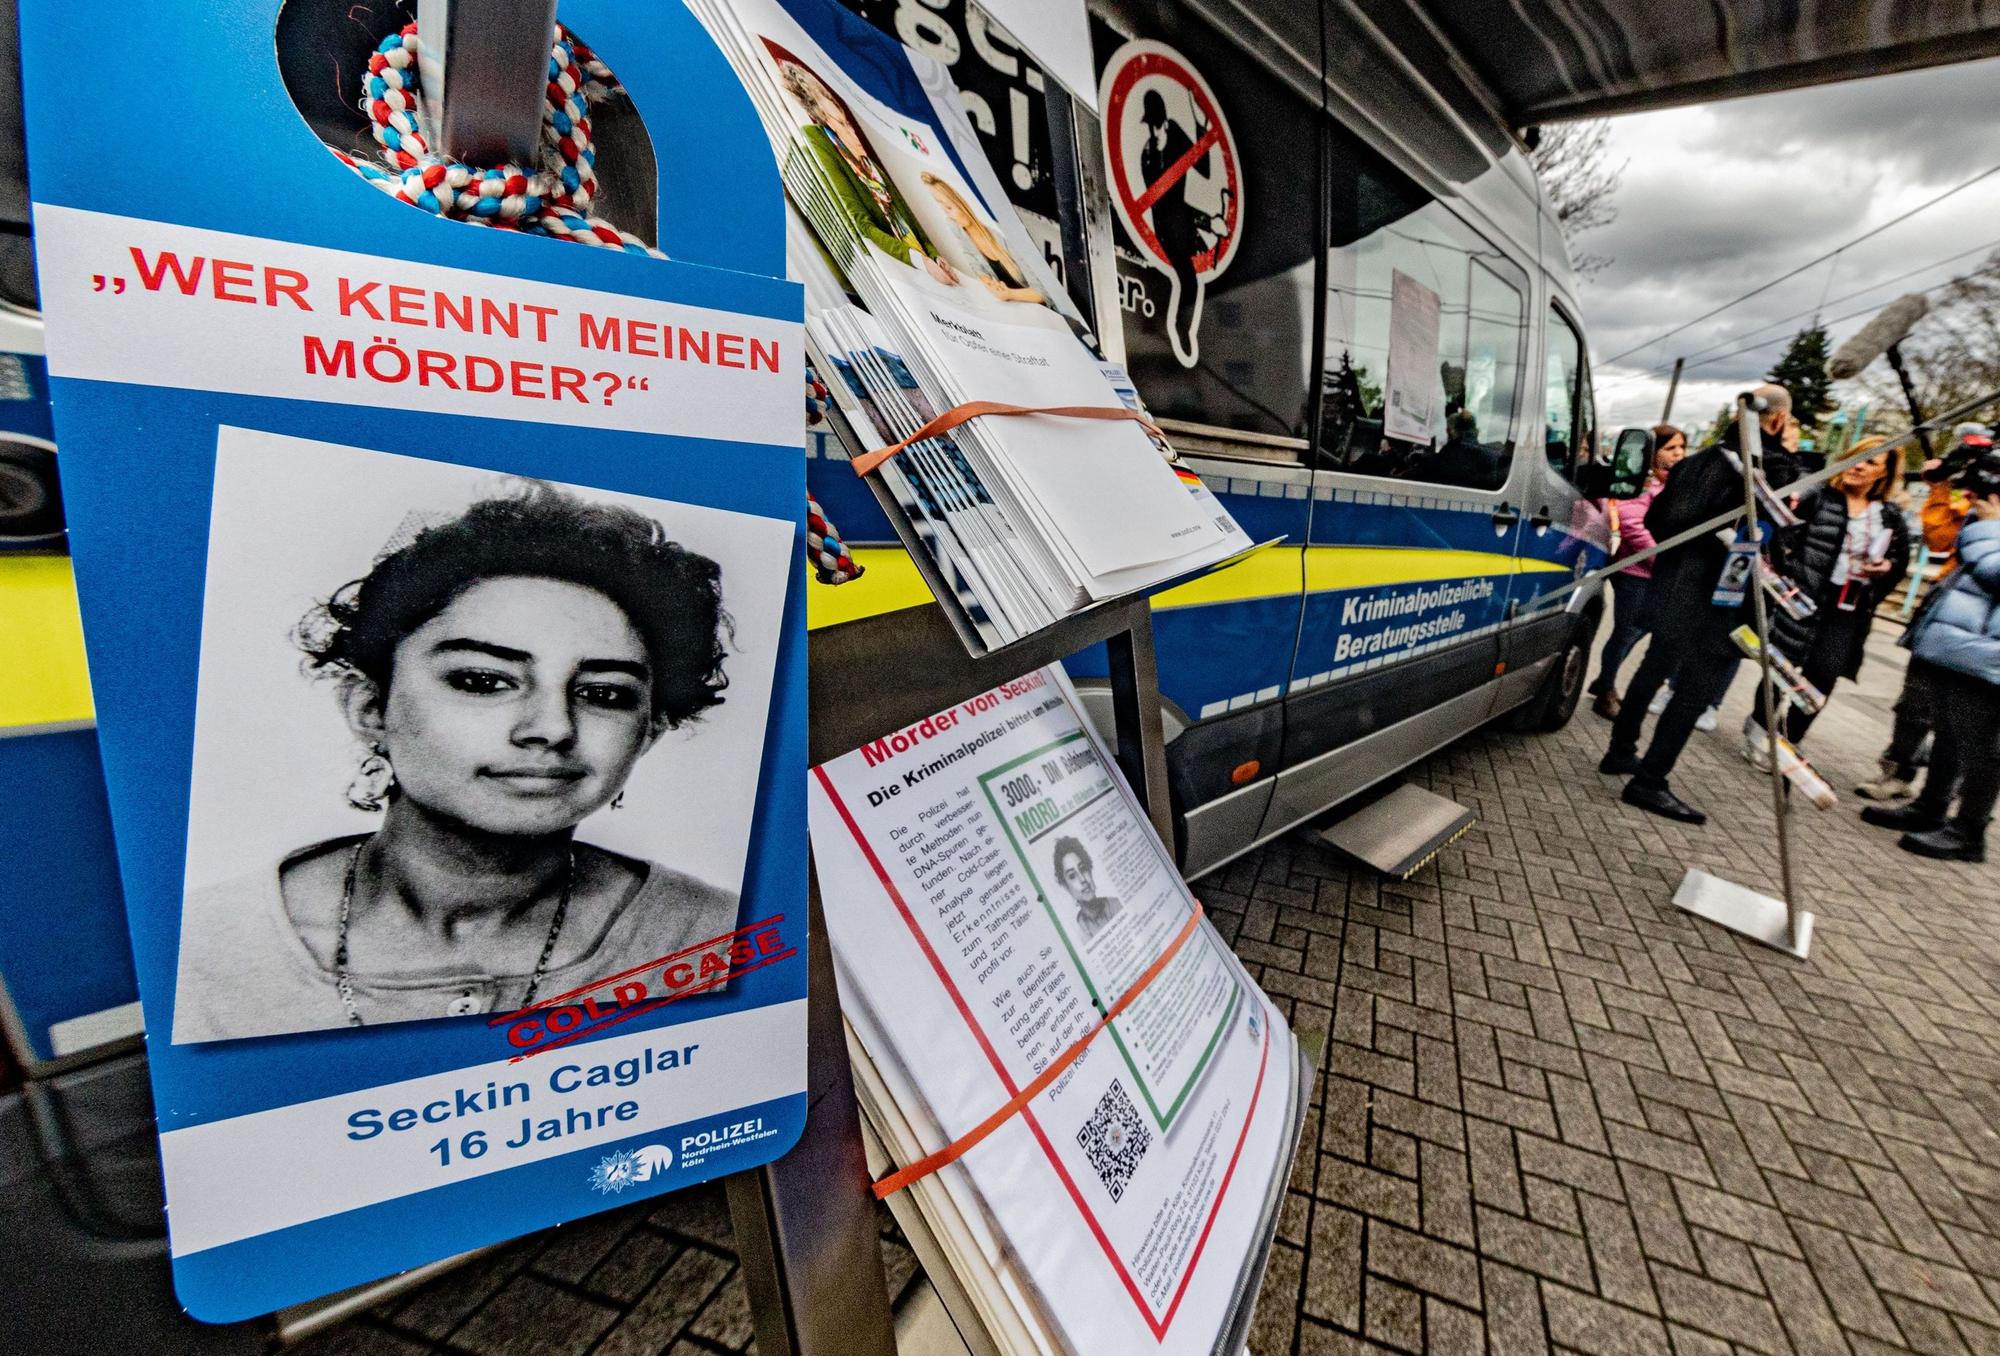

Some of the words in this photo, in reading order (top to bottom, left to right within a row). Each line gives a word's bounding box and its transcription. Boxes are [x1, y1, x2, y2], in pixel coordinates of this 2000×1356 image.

[337, 276, 560, 343] KENNT
[578, 312, 781, 374] MEINEN
[929, 310, 986, 341] Merkblatt
[302, 334, 651, 407] MÖRDER?“
[1340, 577, 1494, 626] Kriminalpolizeiliche
[1332, 608, 1466, 663] Beratungsstelle
[859, 707, 961, 769] Mörder
[962, 690, 1001, 718] von
[998, 670, 1048, 701] Seckin?
[866, 782, 902, 808] Die
[902, 722, 1008, 788] Kriminalpolizei
[1007, 710, 1034, 731] bittet
[889, 824, 909, 841] Die
[917, 799, 949, 823] Polizei
[955, 785, 971, 799] hat
[898, 831, 927, 854] durch
[934, 799, 976, 830] verbesser-
[906, 854, 917, 867] te
[920, 823, 964, 857] Methoden
[967, 811, 983, 825] nun
[1013, 796, 1061, 840] MORD
[913, 836, 969, 880] DNA-Spuren
[975, 824, 988, 838] ge-
[921, 866, 957, 893] funden.
[959, 844, 983, 864] Nach
[929, 887, 947, 906] ner
[957, 848, 1001, 884] Cold-Case-
[937, 886, 974, 919] Analyse
[984, 858, 1008, 881] liegen
[945, 910, 967, 934] jetzt
[978, 871, 1015, 906] genauere
[961, 935, 983, 957] zum
[984, 895, 1029, 936] Tathergang
[969, 950, 989, 971] und
[990, 931, 1010, 952] zum
[1009, 908, 1033, 932] Täter-
[506, 978, 648, 1049] COLD
[661, 926, 786, 990] CASE
[977, 959, 1001, 985] profil
[998, 944, 1016, 962] vor.
[992, 988, 1012, 1010] Wie
[1016, 962, 1037, 987] auch
[1039, 945, 1053, 961] Sie
[1000, 1003, 1017, 1024] zur
[1022, 958, 1060, 1000] Identifizie-
[1009, 1012, 1031, 1036] rung
[1028, 995, 1045, 1014] des
[1041, 970, 1067, 998] Täters
[1016, 1006, 1054, 1049] beitragen
[1055, 985, 1072, 1005] kön-
[1049, 996, 1079, 1033] erfahren
[1032, 1054, 1050, 1076] Sie
[1049, 1039, 1064, 1058] auf
[1061, 1022, 1076, 1041] der
[345, 1080, 532, 1143] Seckin
[548, 1041, 701, 1102] Caglar
[1048, 1067, 1076, 1102] Polizei
[428, 1129, 490, 1168] 16
[504, 1097, 640, 1151] Jahre
[681, 1117, 763, 1152] POLIZEI
[681, 1128, 778, 1160] Nordrhein-Westfalen
[681, 1157, 705, 1169] Köln
[1131, 1225, 1155, 1269] Hinweise
[1152, 1207, 1165, 1228] bitte
[1149, 1273, 1163, 1300] oder
[1160, 1261, 1170, 1278] an
[1165, 1239, 1180, 1265] jede
[1175, 1211, 1192, 1243] andere
